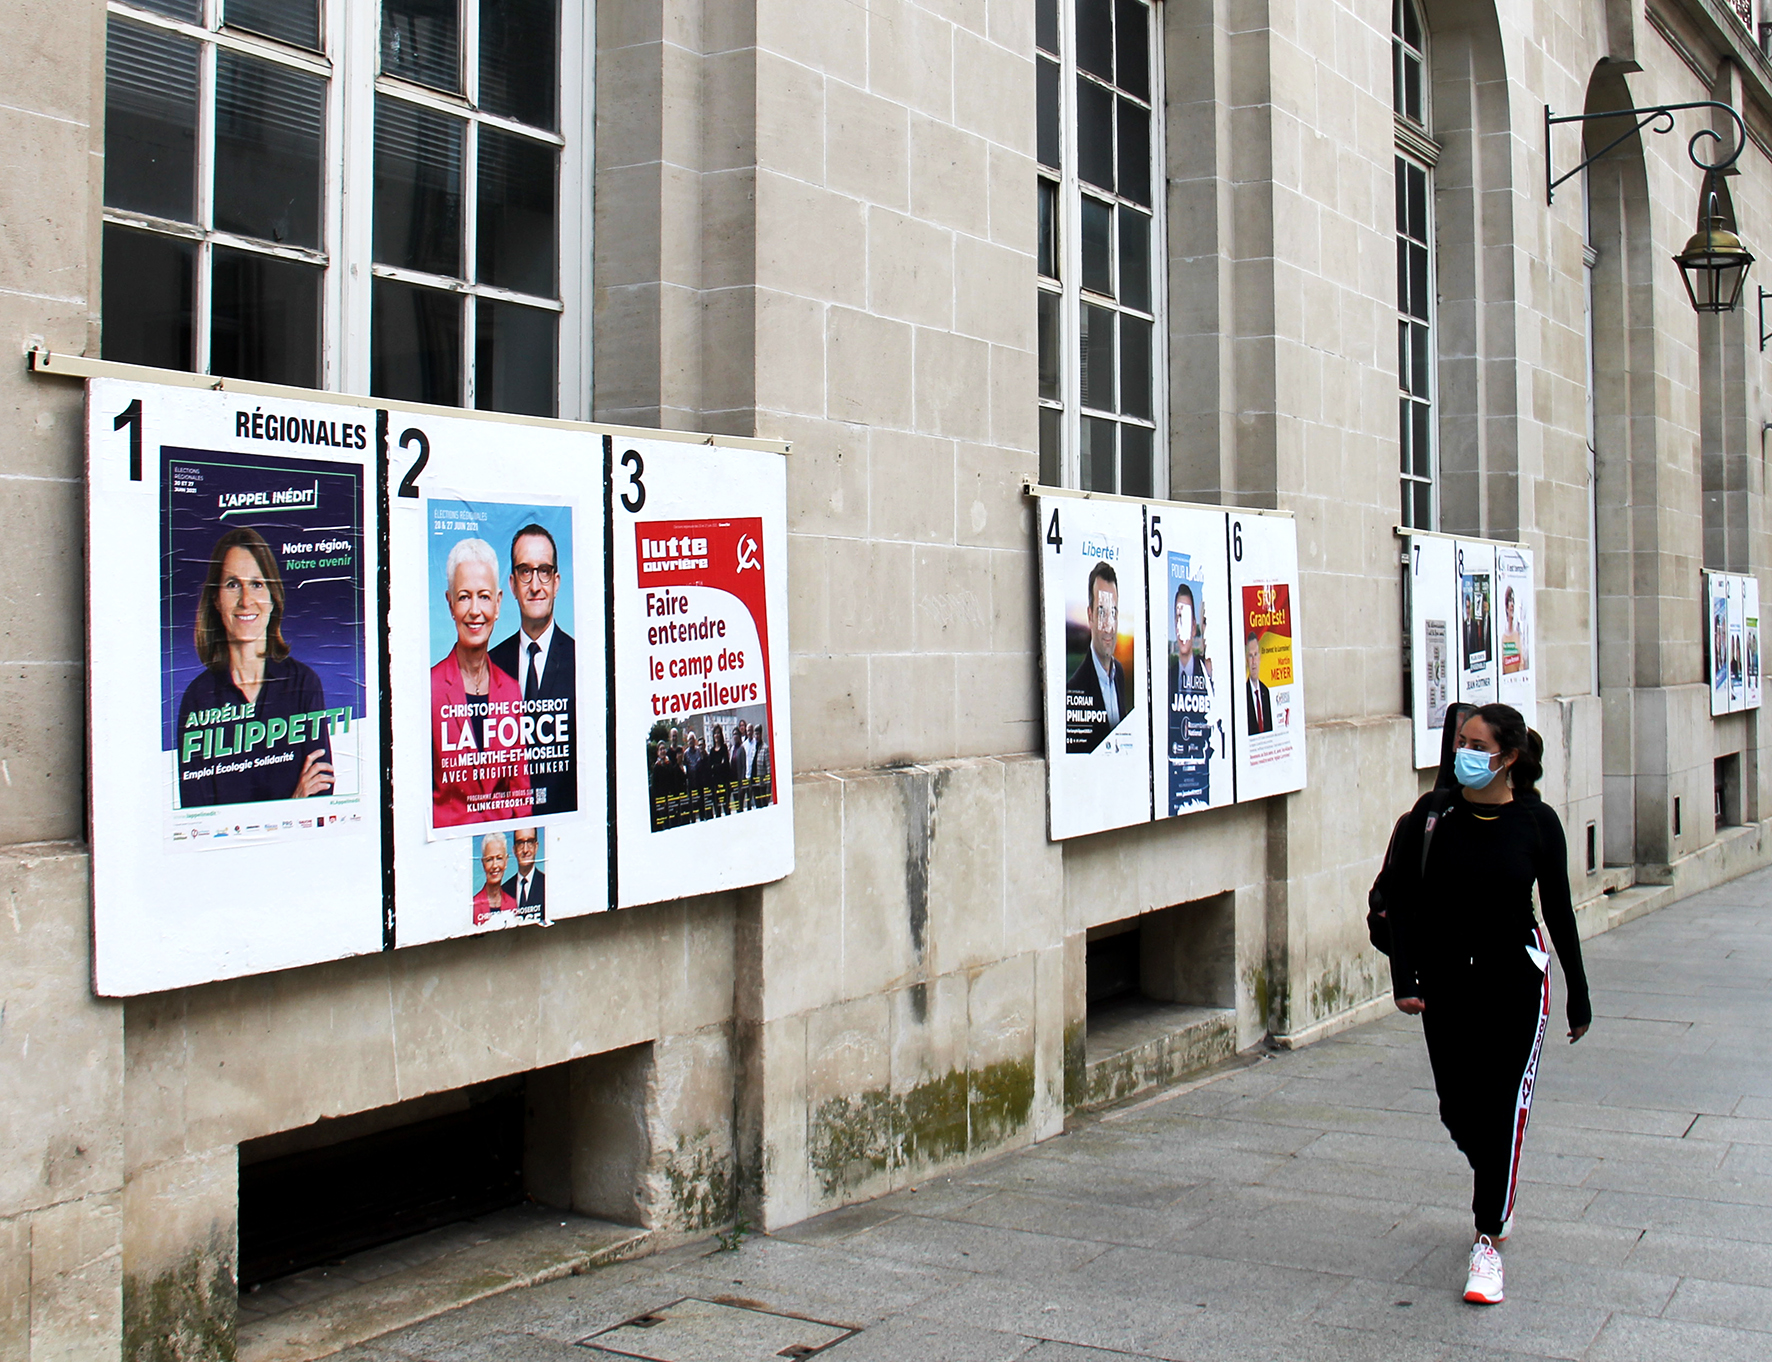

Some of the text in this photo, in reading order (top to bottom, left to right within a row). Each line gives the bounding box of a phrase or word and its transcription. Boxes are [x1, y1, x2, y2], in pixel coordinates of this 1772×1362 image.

[113, 398, 142, 481] 1
[235, 407, 366, 450] RÉGIONALES
[174, 466, 200, 474] ÉLECTIONS
[397, 427, 430, 498] 2
[174, 473, 204, 481] RÉGIONALES
[620, 449, 646, 513] 3
[218, 487, 314, 507] L'APPEL INÉDIT
[434, 508, 459, 519] ÉLECTIONS
[434, 521, 441, 530] 20
[442, 522, 446, 530] &
[447, 522, 453, 530] 27
[454, 522, 465, 531] JUIN
[1047, 508, 1063, 554] 4
[1151, 516, 1162, 558] 5
[1233, 521, 1243, 562] 6
[282, 538, 352, 555] Notre région,
[641, 536, 708, 559] lutte
[1082, 541, 1114, 560] Liberté
[286, 554, 352, 571] Notre avenir
[643, 558, 709, 573] ouvrière
[1414, 545, 1420, 576] 7
[1458, 548, 1464, 578] 8
[646, 590, 689, 617] Faire
[1257, 589, 1277, 607] STOP
[648, 616, 726, 646] entendre
[1249, 611, 1270, 628] Grand
[649, 648, 744, 681] le camp des
[1271, 667, 1291, 681] MEYER
[440, 698, 568, 719] CHRISTOPHE CHOSEROT
[651, 681, 758, 717] travailleurs
[1067, 695, 1094, 706] FLORIAN
[185, 702, 257, 728] AURÉLIE
[1067, 709, 1107, 723] PHILIPPOT
[182, 706, 353, 763] FILIPPETTI
[441, 713, 569, 752] LA FORCE
[183, 751, 295, 780] Emploi Écologie Solidarité
[441, 744, 569, 769] DE LA MEURTHE-ET-MOSELLE
[442, 759, 570, 784] AVEC BRIGITTE KLINKERT
[467, 796, 535, 812] KLINKERT2021.FR
